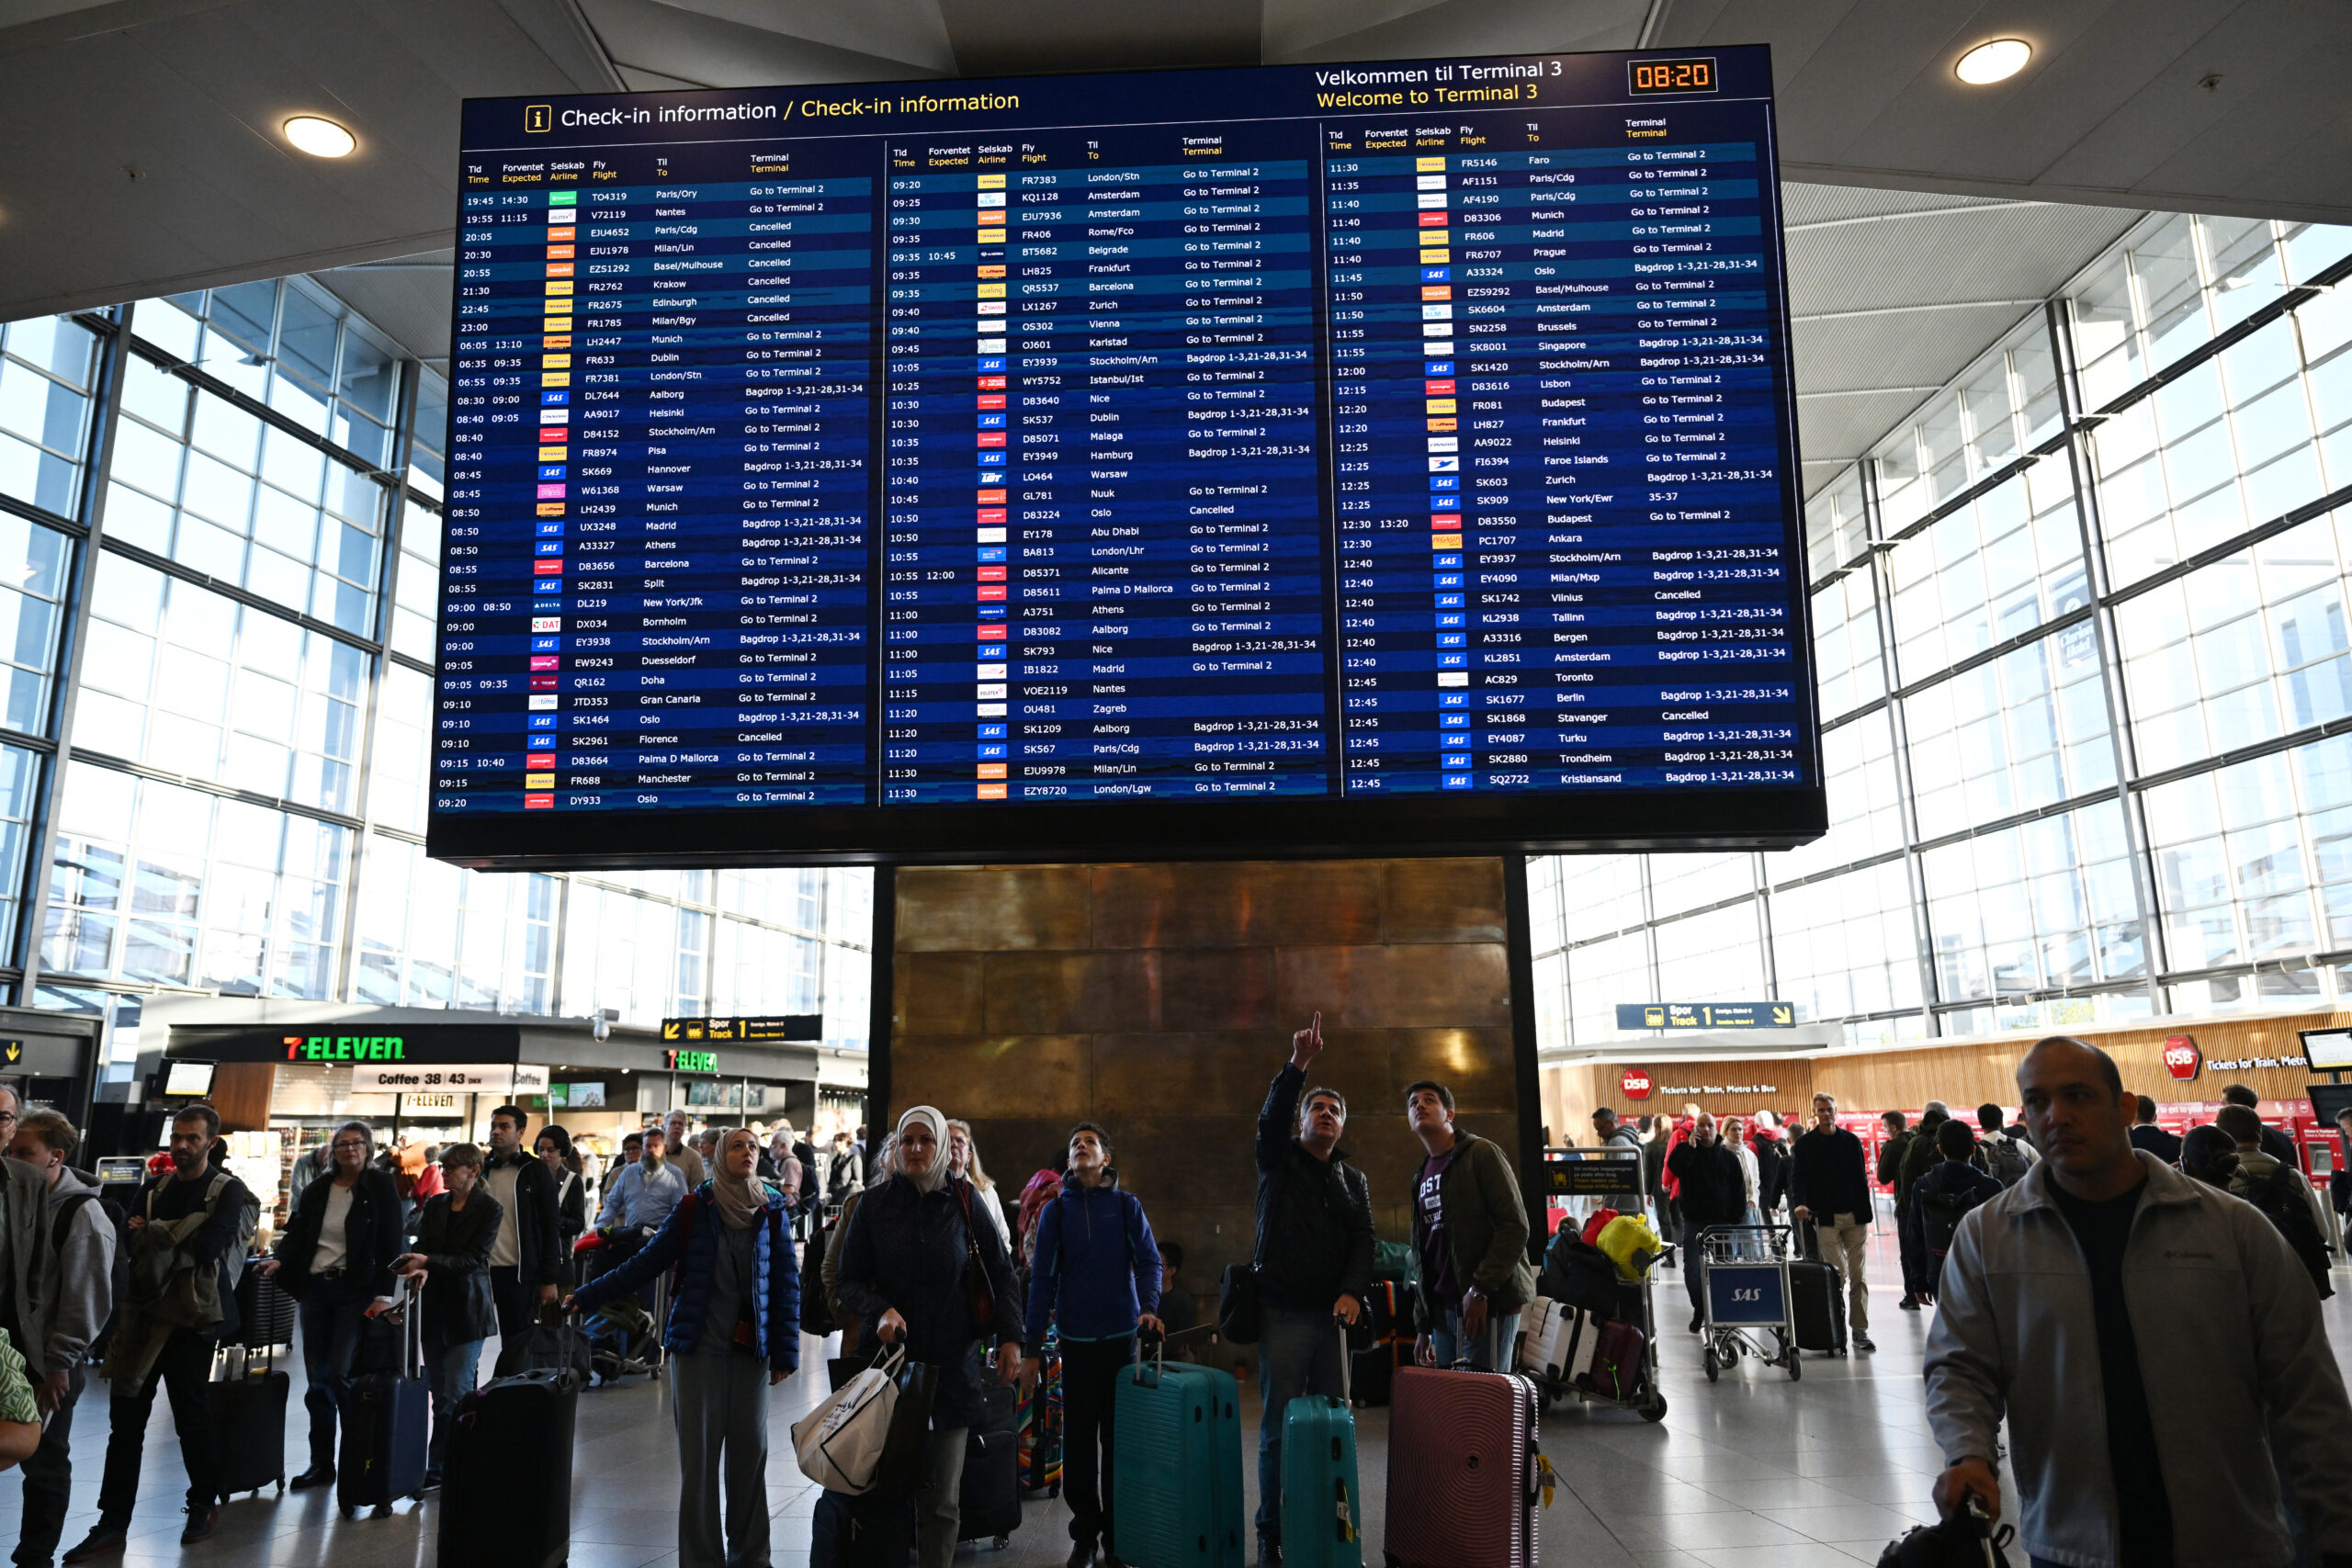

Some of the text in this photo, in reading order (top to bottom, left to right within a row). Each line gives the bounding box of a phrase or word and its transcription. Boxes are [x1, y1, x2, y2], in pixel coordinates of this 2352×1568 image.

[1315, 60, 1563, 86] Velkommen til Terminal 3
[1637, 63, 1710, 88] 08:20
[1317, 84, 1538, 107] Welcome to Terminal 3
[561, 93, 1019, 127] Check-in information / Check-in information
[468, 152, 789, 174] Tid Forventet Selskab Fly Til Terminal
[1330, 150, 1706, 173] 11:30 FR5146 Faro Go to Terminal 2
[468, 164, 789, 184] Time Expected Airline Flight To Terminal
[468, 185, 824, 206] 19:45 14:30 TO4319 Paris/Ory Go to Terminal 2
[465, 221, 792, 242] 20:05 EJU4652 Paris/Cdg Cancelled
[1334, 260, 1758, 283] 11:45 SAS A33324 Oslo Bagdrop 1-3,21-28,31-34
[457, 385, 864, 405] 08:30 09:00 SAS DL7644 Aalborg Bagdrop 1-3,21-28,31-34
[891, 445, 1311, 467] 10:35 SAS EY3949 Hamburg Bagdrop 1-3,21-28,31-34
[891, 470, 1128, 485] 10:40 LO464 Warsaw
[1342, 491, 1679, 510] 12:25 SAS SK909 New York/Ewr 35-37
[1345, 590, 1702, 608] 12:40 SAS SK1742 Vilnius Cancelled
[447, 614, 818, 632] 09:00 DAT DX034 Bornholm Go to Terminal 2
[1348, 672, 1594, 687] 12:45 AC829 Toronto
[889, 684, 1126, 698] 11:15 VOE2119 Nantes
[441, 732, 783, 749] 09:10 SAS SK2961 Florence Cancelled
[1351, 771, 1795, 788] 12:45 SAS SQ2722 Kristiansand Bagdrop 1-3,21-28,31-34
[888, 781, 1275, 798] 11:30 EZY8720 London/Lgw Go to Terminal 2
[438, 791, 815, 807] 09:20 DY933 Oslo Go to Terminal 2
[1669, 1005, 1692, 1016] Spor
[1702, 1007, 1712, 1026] 1
[1670, 1016, 1698, 1026] Track
[709, 1019, 730, 1030] Spor
[739, 1020, 747, 1039] 1
[709, 1029, 733, 1039] Track
[2165, 1050, 2194, 1066] DSB
[2206, 1060, 2238, 1071] Tickets
[2239, 1058, 2252, 1069] for
[2255, 1057, 2279, 1068] Train,
[379, 1073, 420, 1085] Coffee
[424, 1073, 442, 1085] 38
[448, 1073, 465, 1085] 43
[514, 1072, 541, 1086] Coffee
[1623, 1077, 1649, 1090] DSB
[1660, 1086, 1689, 1095] Tickets
[1690, 1086, 1702, 1094] for
[1703, 1085, 1725, 1094] Train,
[1726, 1085, 1752, 1094] Metro
[1761, 1085, 1777, 1093] Bus
[1730, 1288, 1762, 1302] SAS
